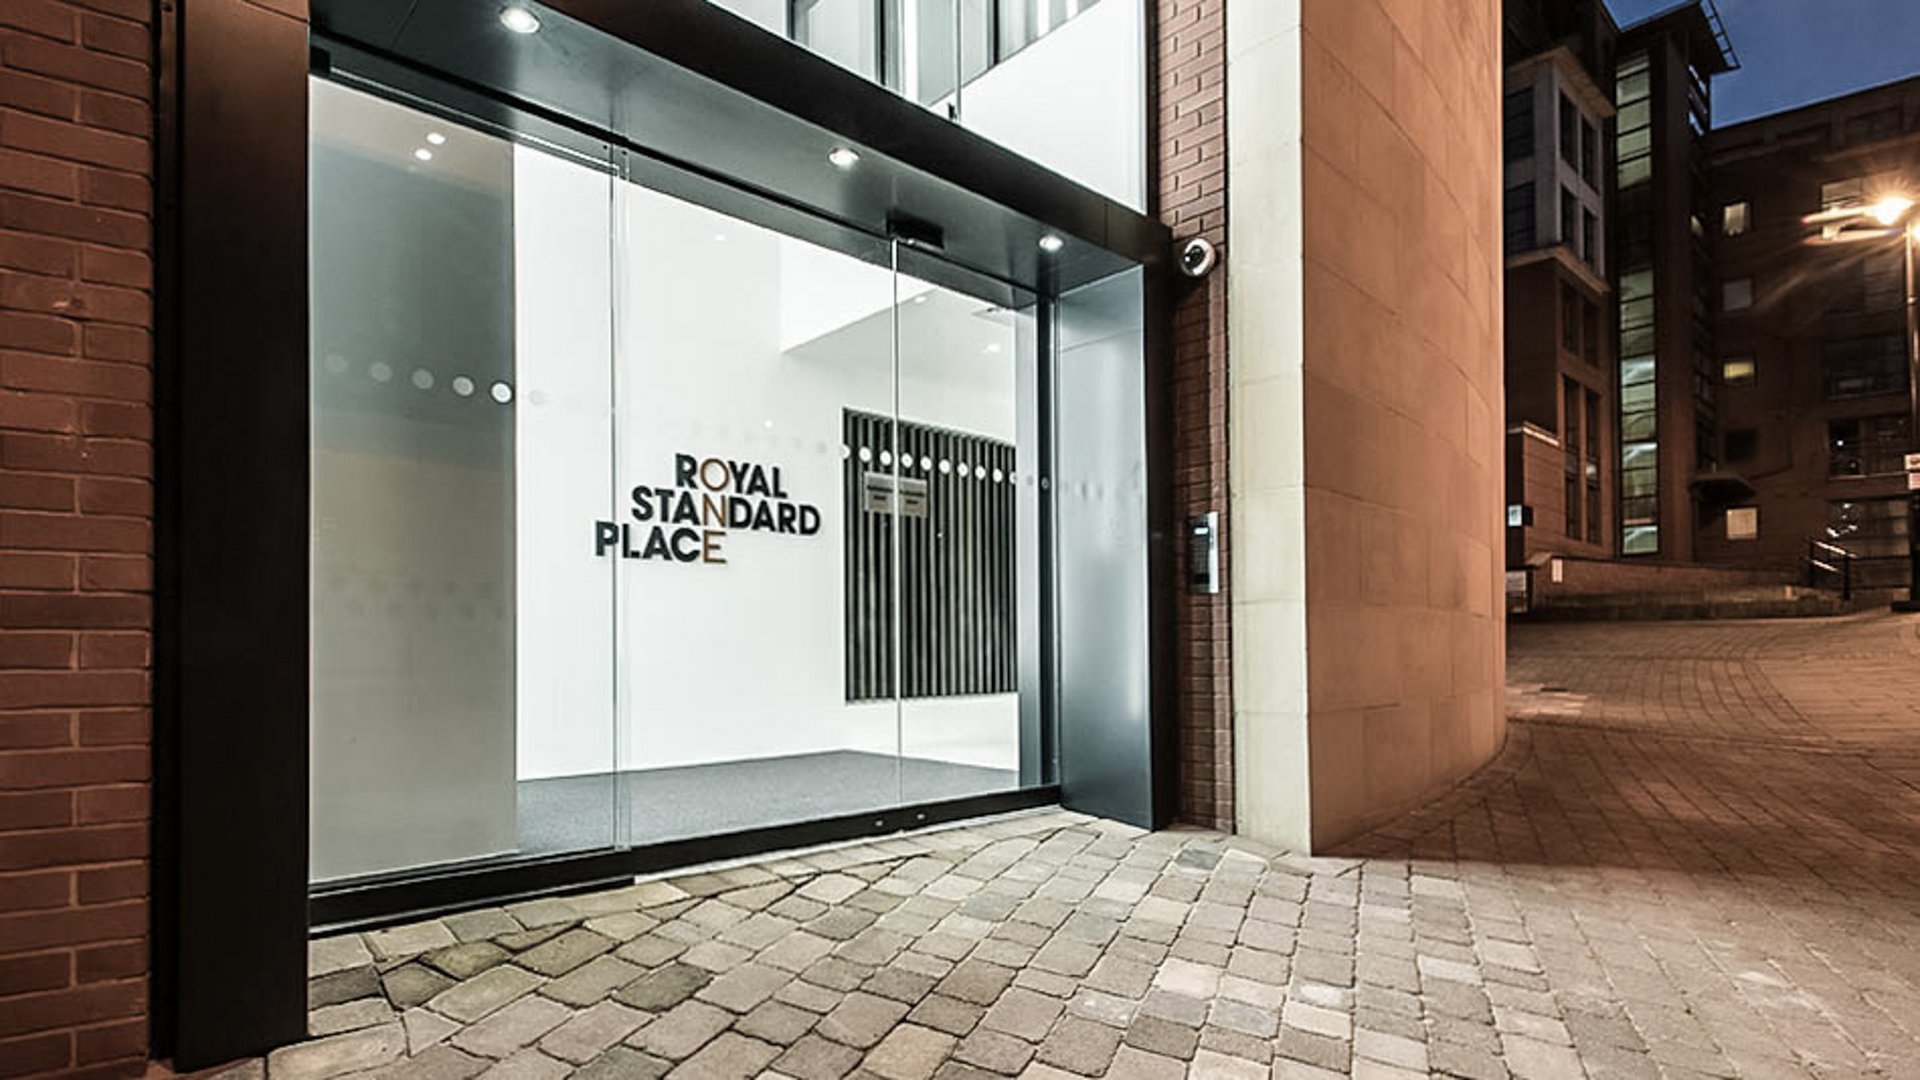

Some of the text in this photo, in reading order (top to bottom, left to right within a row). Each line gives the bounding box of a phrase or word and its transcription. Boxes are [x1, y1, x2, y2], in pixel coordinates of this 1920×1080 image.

[675, 453, 788, 499] ROYAL
[631, 485, 821, 536] STANDARD
[595, 520, 727, 564] PLACE
